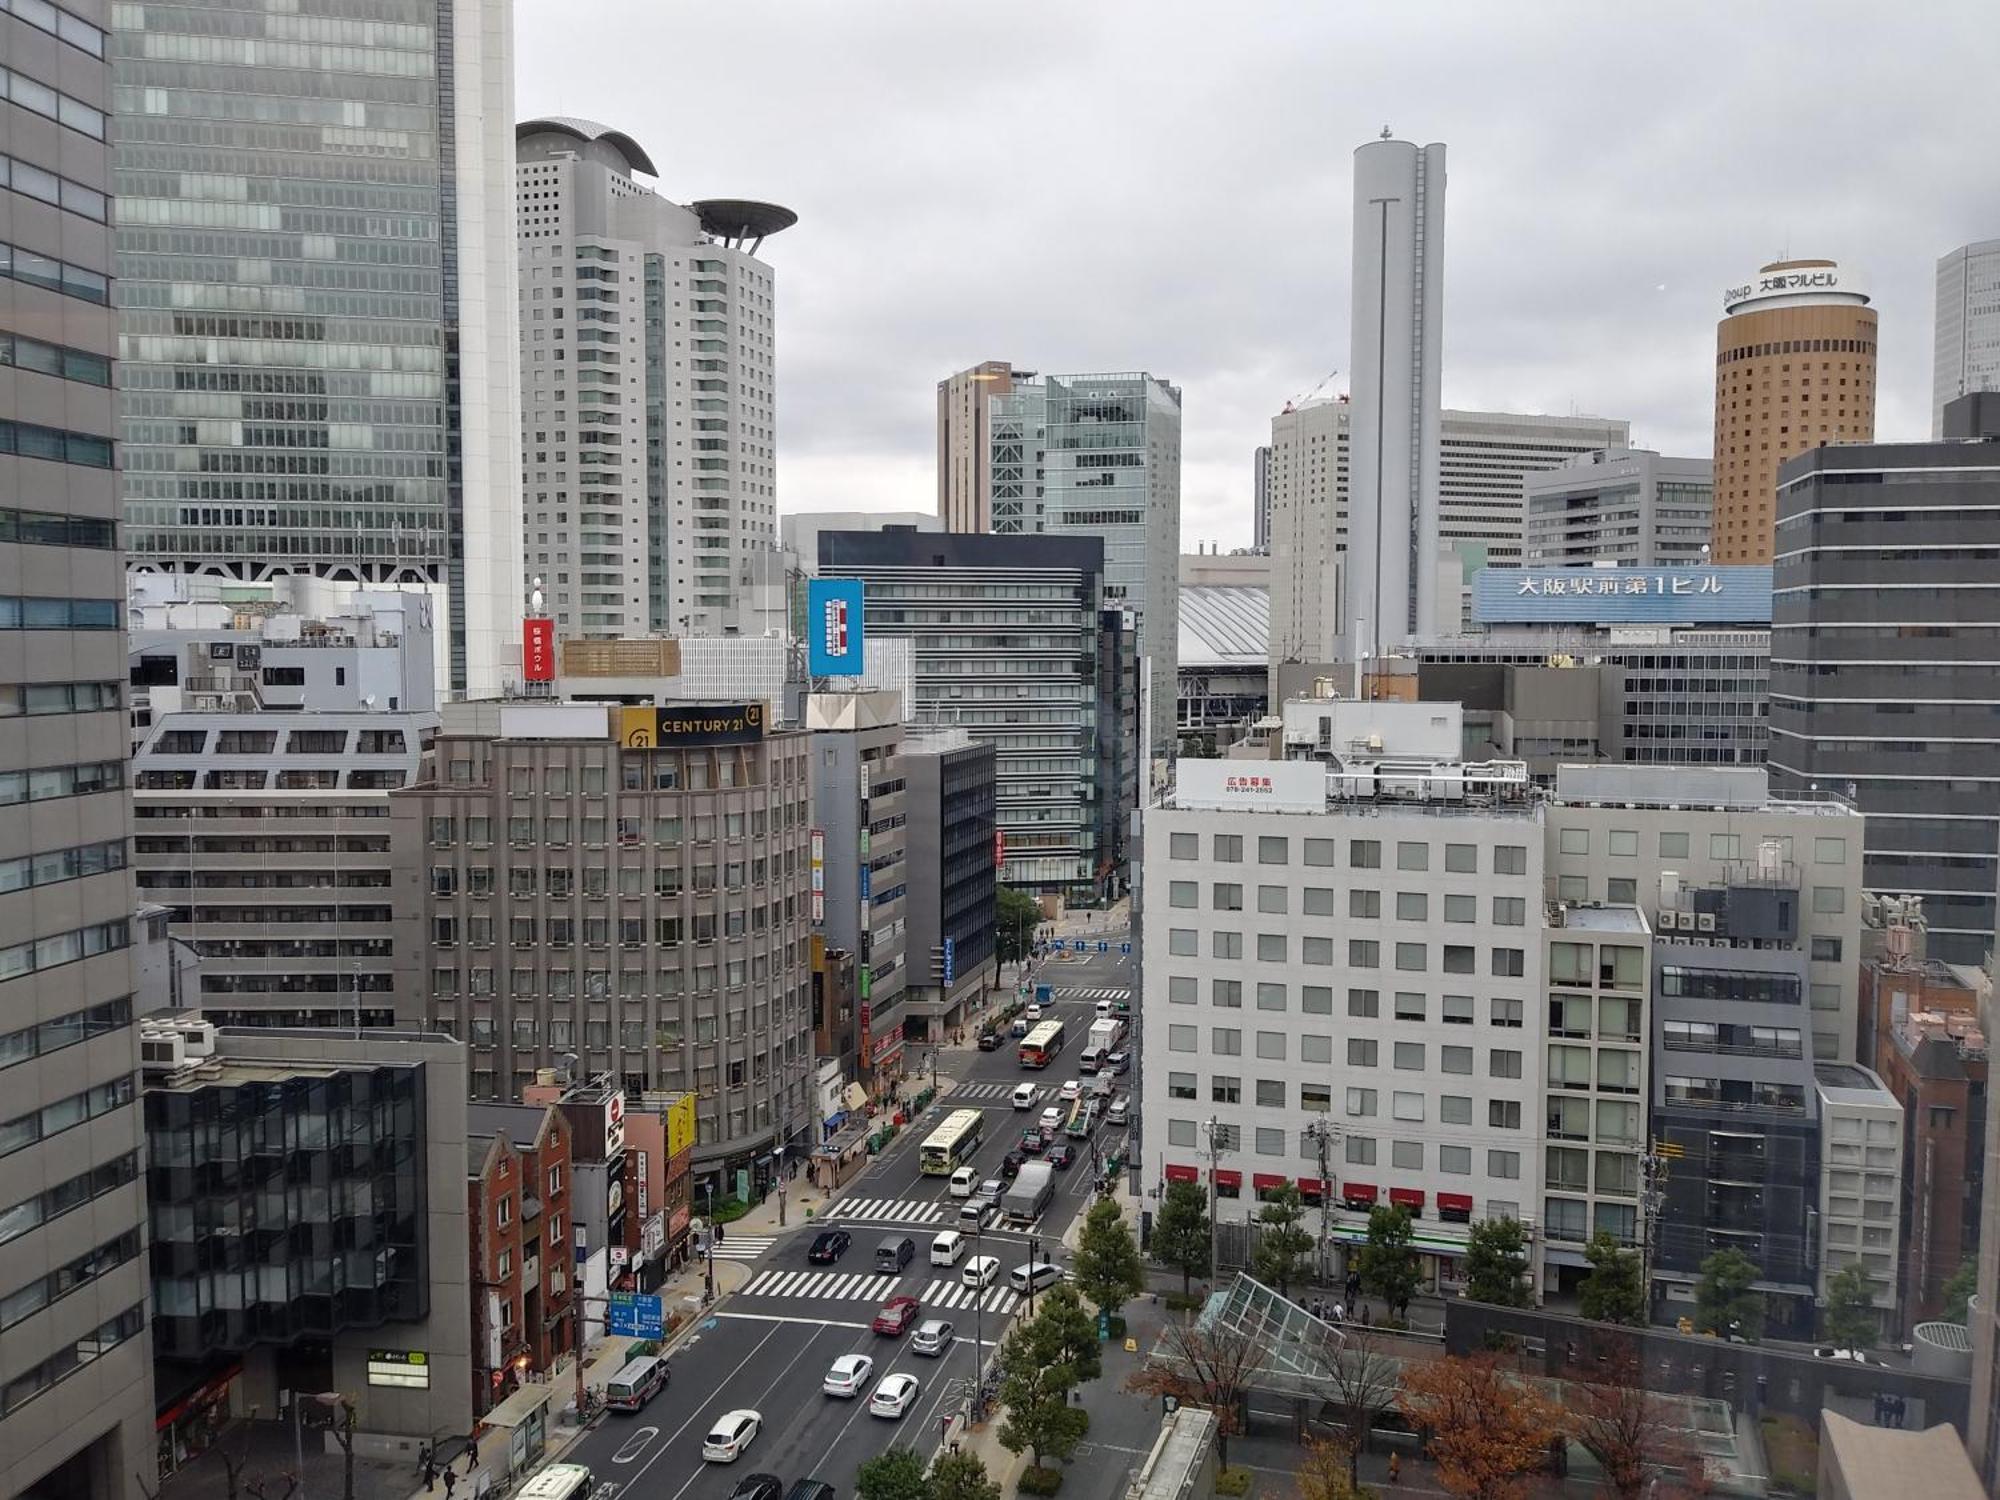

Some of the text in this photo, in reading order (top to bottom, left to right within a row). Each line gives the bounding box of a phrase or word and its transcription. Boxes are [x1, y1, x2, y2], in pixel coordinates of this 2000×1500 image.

[1760, 273, 1837, 292] 大阪マルビル
[1518, 576, 1723, 595] 大阪駅前第1ビル
[662, 719, 744, 733] CENTURY 21
[635, 735, 649, 747] 21
[1227, 776, 1272, 786] 広告募集
